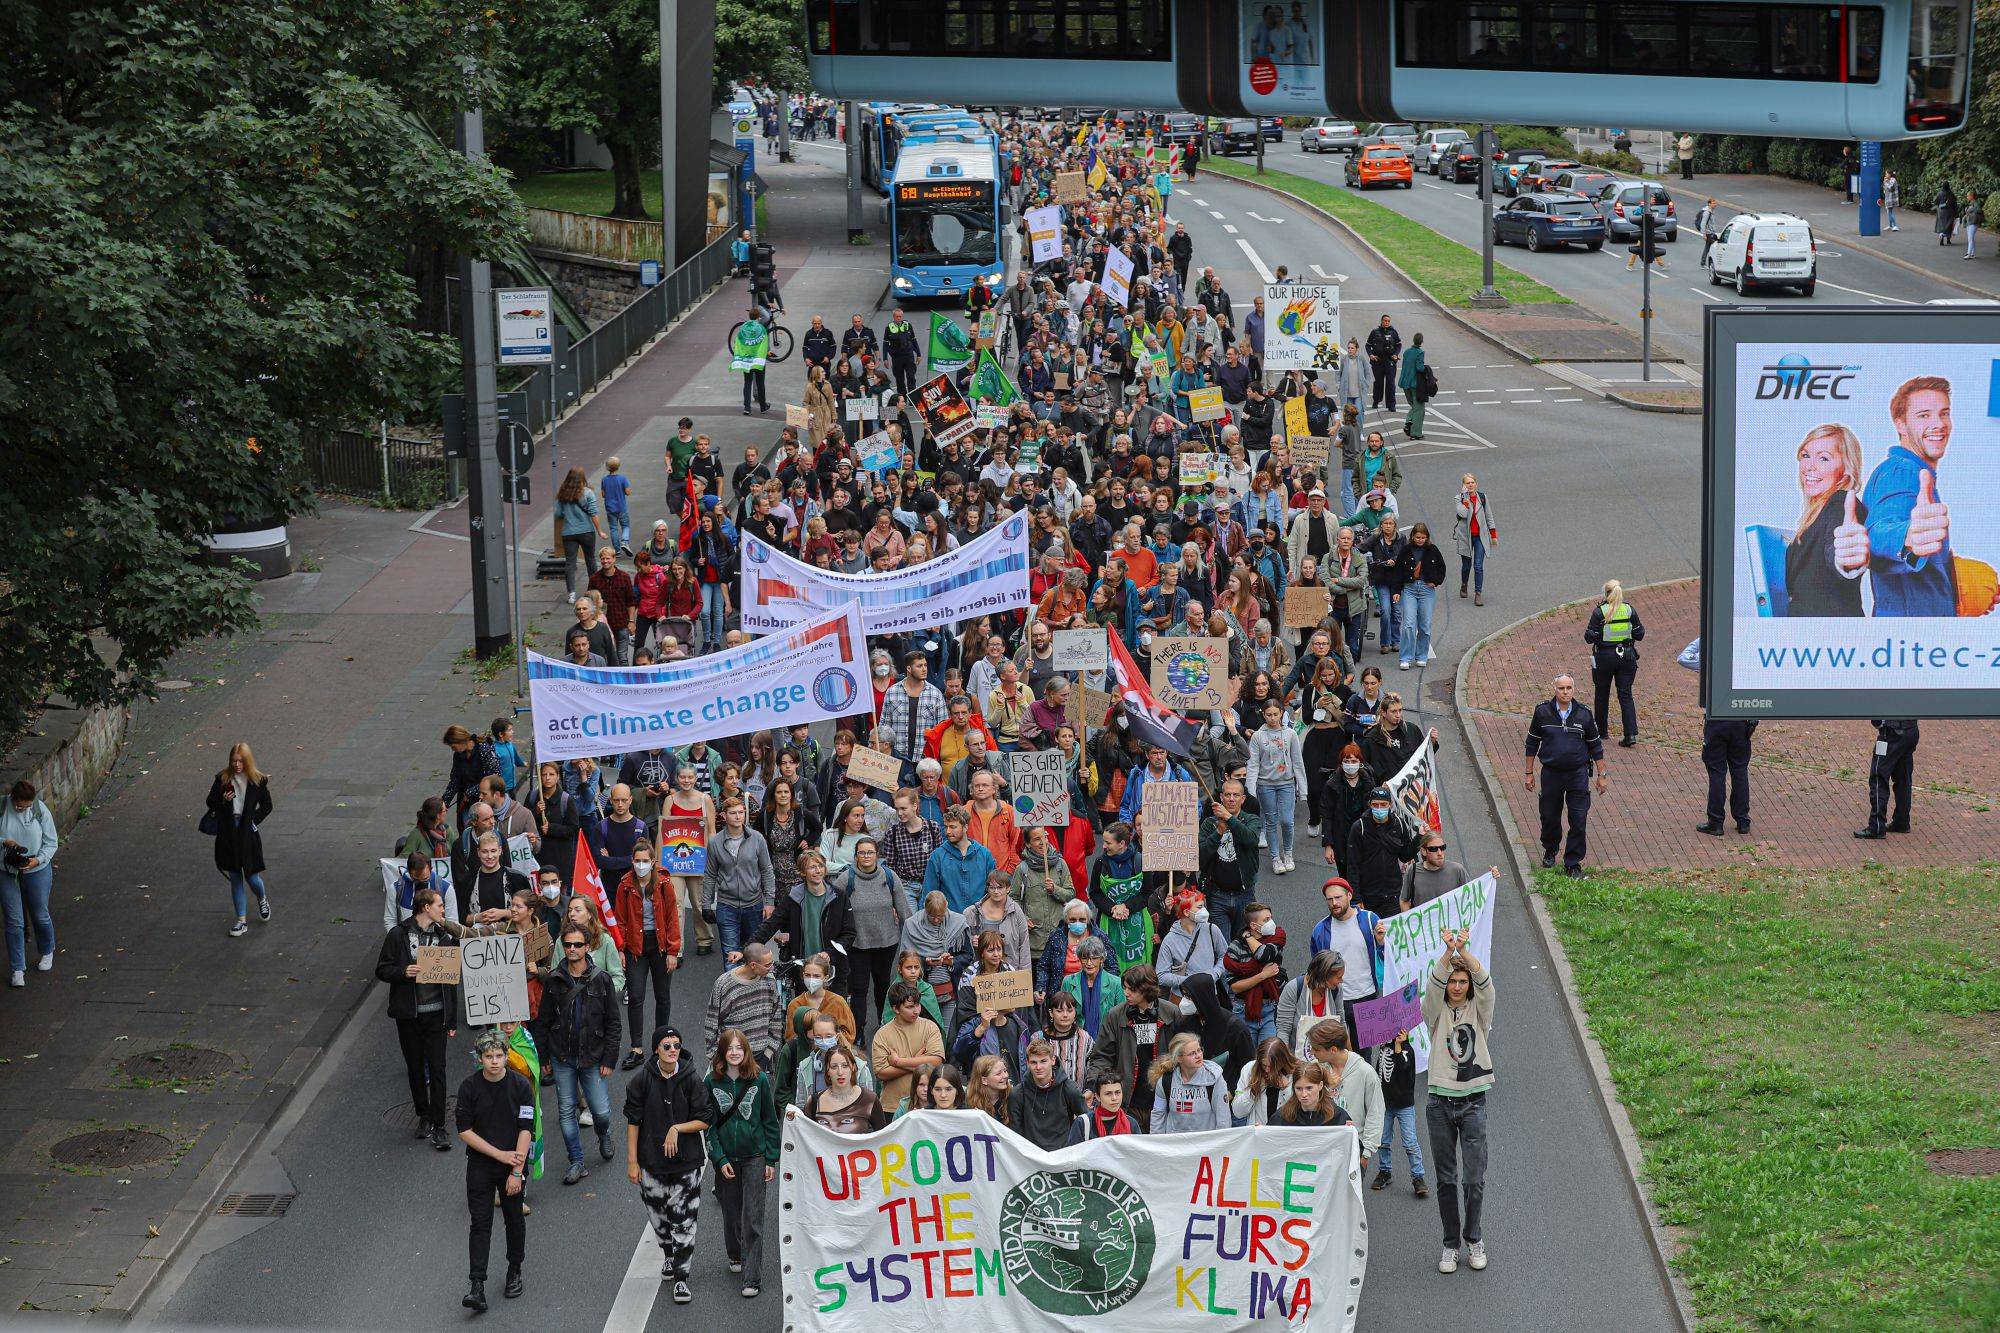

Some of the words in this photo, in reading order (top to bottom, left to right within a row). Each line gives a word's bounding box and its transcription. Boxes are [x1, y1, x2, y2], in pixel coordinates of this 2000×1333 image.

[902, 187, 917, 199] 619
[1268, 286, 1287, 299] OUR
[1292, 286, 1326, 299] HOUSE
[1323, 299, 1331, 308] IS
[1327, 306, 1338, 316] ON
[1307, 321, 1332, 334] FIRE
[1265, 349, 1300, 360] CLIMATE
[1293, 359, 1310, 369] HERO
[922, 385, 942, 402] SUV
[946, 420, 976, 441] PARTEI
[1285, 603, 1312, 612] EARTH
[1153, 641, 1182, 665] THERE
[1188, 641, 1198, 651] IS
[1203, 643, 1223, 665] NO
[1757, 638, 2000, 669] www.ditec-z
[643, 686, 663, 695] 2019
[809, 640, 833, 653] Jahre
[1158, 685, 1199, 709] PLANET
[1205, 688, 1222, 707] B
[1730, 698, 1773, 709] STRÖER
[548, 715, 579, 732] act
[581, 708, 694, 738] Climate
[701, 683, 806, 722] change
[550, 733, 568, 741] now
[1011, 754, 1033, 773] ES
[1036, 754, 1065, 772] GIBT
[1013, 773, 1063, 794] KEINEN
[1144, 784, 1198, 803] CLIMATE
[1142, 802, 1196, 828] JUSTICE
[682, 828, 689, 837] IS
[689, 829, 701, 839] MY
[1146, 832, 1199, 849] SOCIAL
[673, 859, 695, 871] HOME?
[1143, 851, 1197, 869] JUSTICE
[422, 949, 436, 957] NO
[439, 948, 457, 959] ICE
[462, 936, 523, 970] GANZ
[466, 972, 514, 988] DÜNNES
[467, 995, 501, 1018] EIS
[815, 1133, 1001, 1201] UPROOT
[1189, 1156, 1317, 1214] ALLE
[878, 1191, 976, 1246] THE
[1001, 1193, 1033, 1286] FRIDAYS
[1018, 1171, 1060, 1201] FOR
[1063, 1170, 1151, 1227] FUTURE
[1182, 1208, 1312, 1271] FÜRS
[813, 1247, 1006, 1313] SYSTEM
[1084, 1275, 1139, 1313] Wuppertal
[1175, 1265, 1312, 1324] KLIMA
